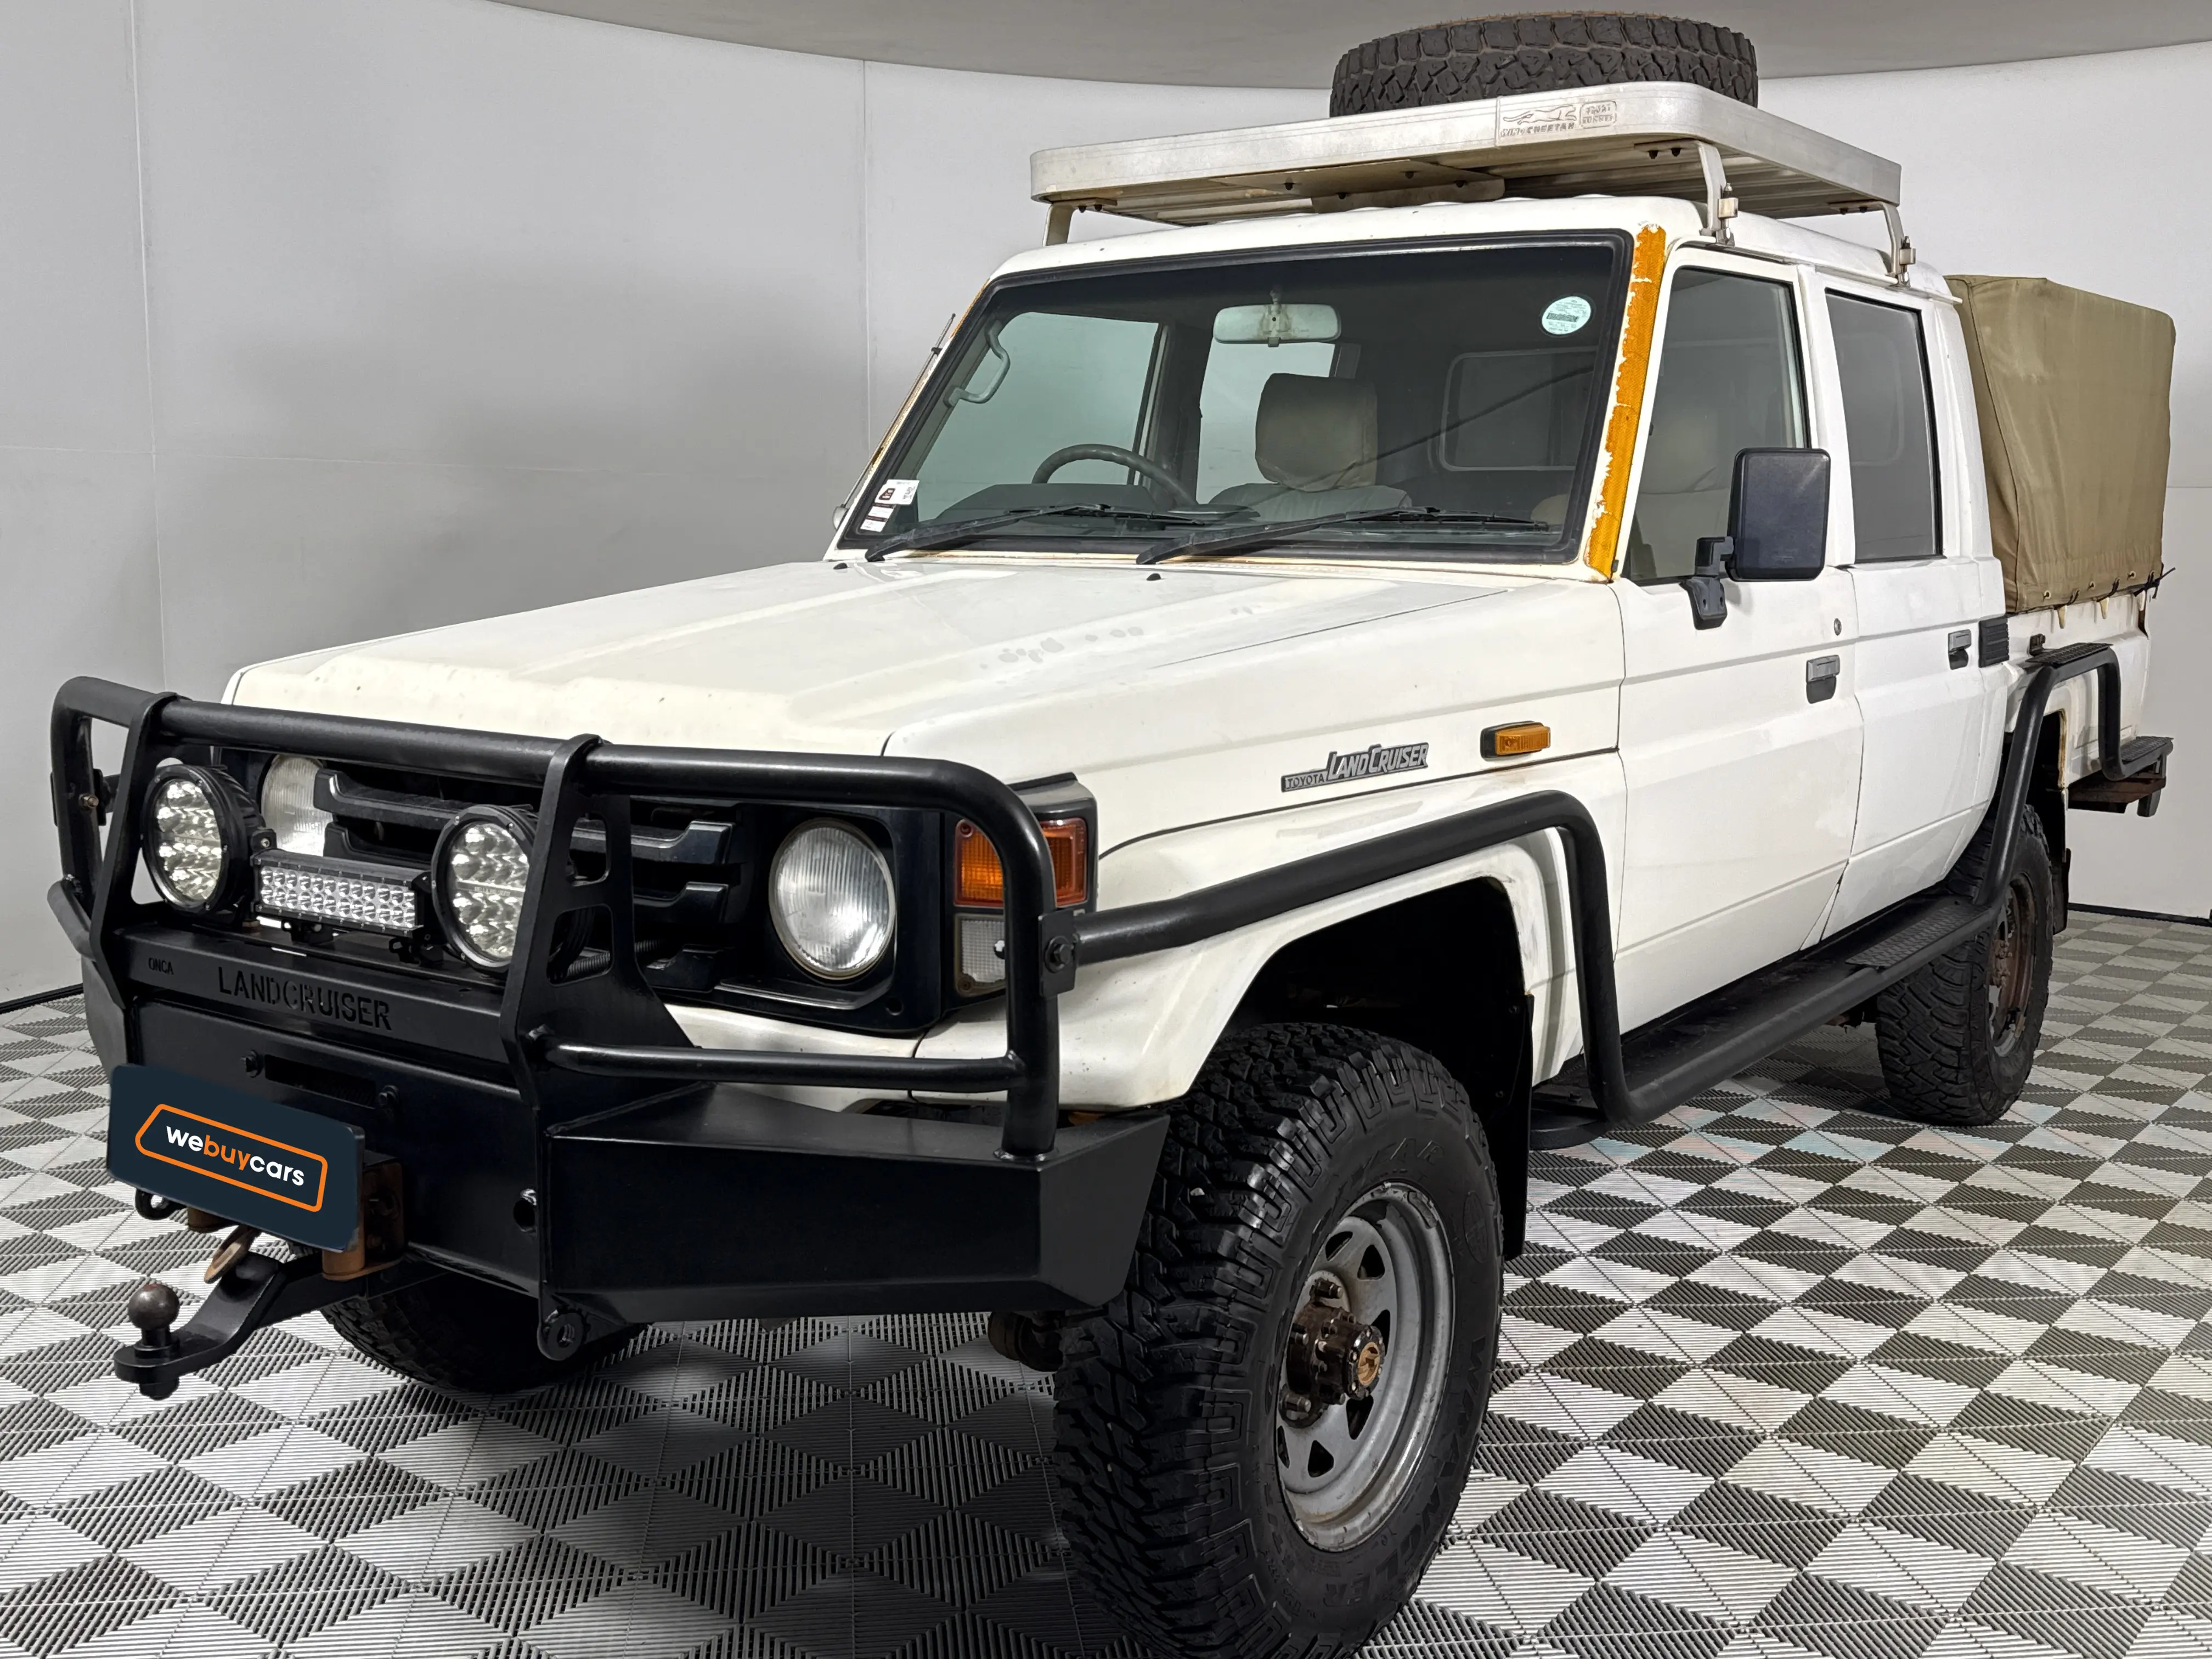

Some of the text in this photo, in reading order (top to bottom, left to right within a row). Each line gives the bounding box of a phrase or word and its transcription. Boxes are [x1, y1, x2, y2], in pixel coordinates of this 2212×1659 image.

[1526, 122, 1575, 134] CHEETAH
[1287, 772, 1325, 786] TOYOTA
[148, 957, 174, 975] ONCA
[218, 966, 392, 1031] LANDCRUISER
